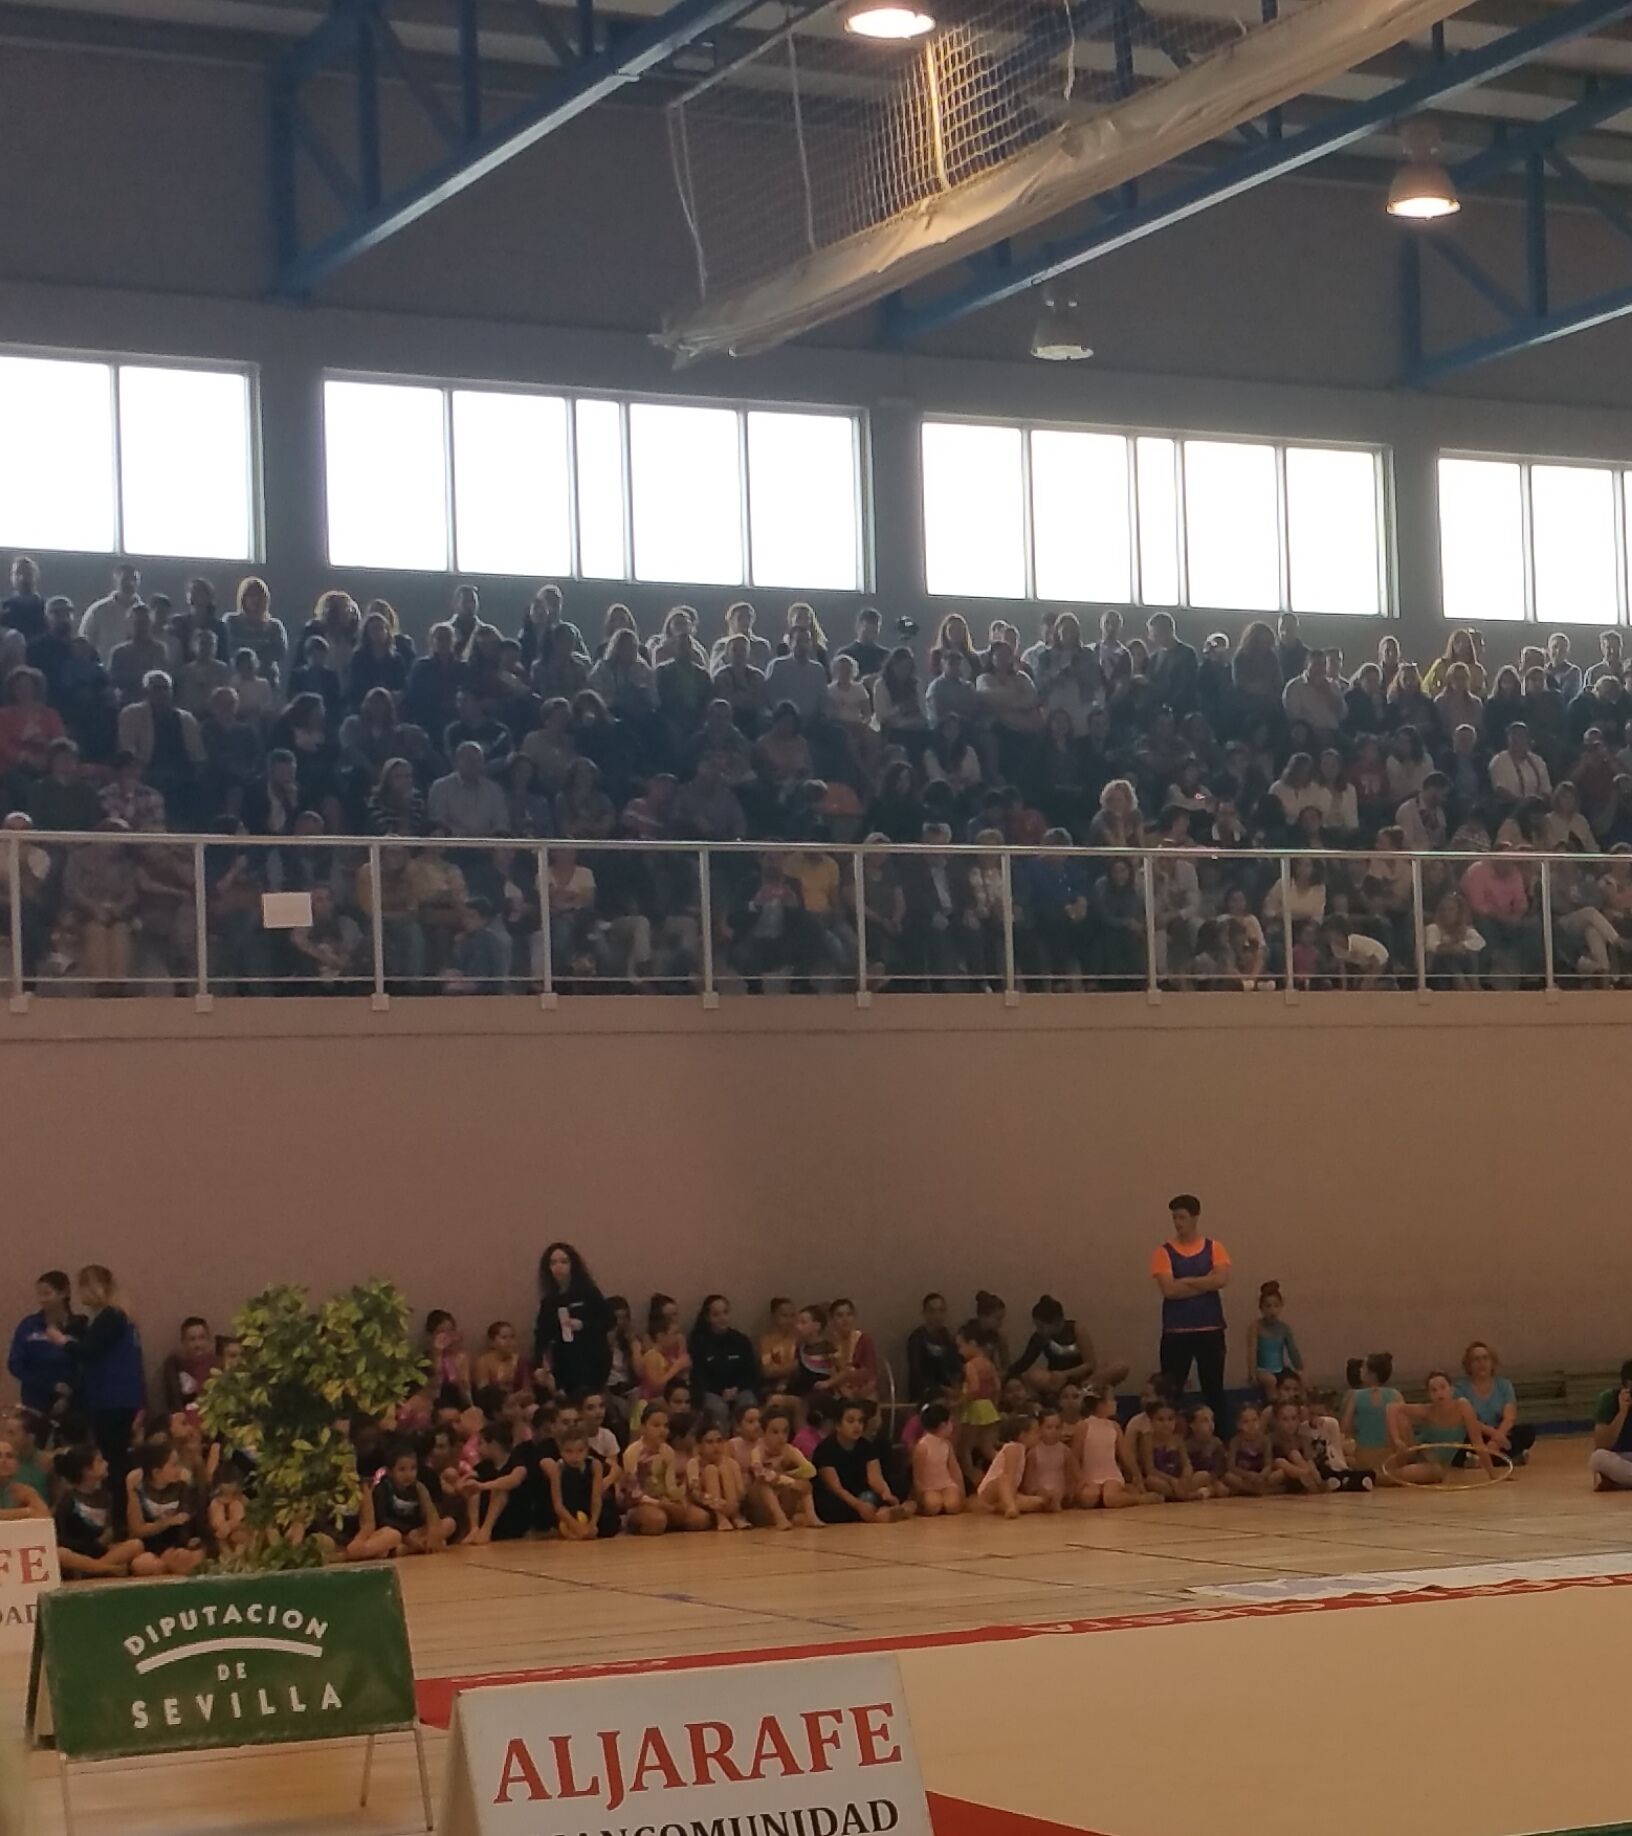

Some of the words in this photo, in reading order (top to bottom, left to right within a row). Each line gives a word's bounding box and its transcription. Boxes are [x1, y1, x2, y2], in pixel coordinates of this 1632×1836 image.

[124, 1603, 328, 1656] DIPUTACION
[217, 1662, 247, 1681] DE
[131, 1682, 342, 1729] SEVILLA
[493, 1702, 902, 1811] ALJARAFE
